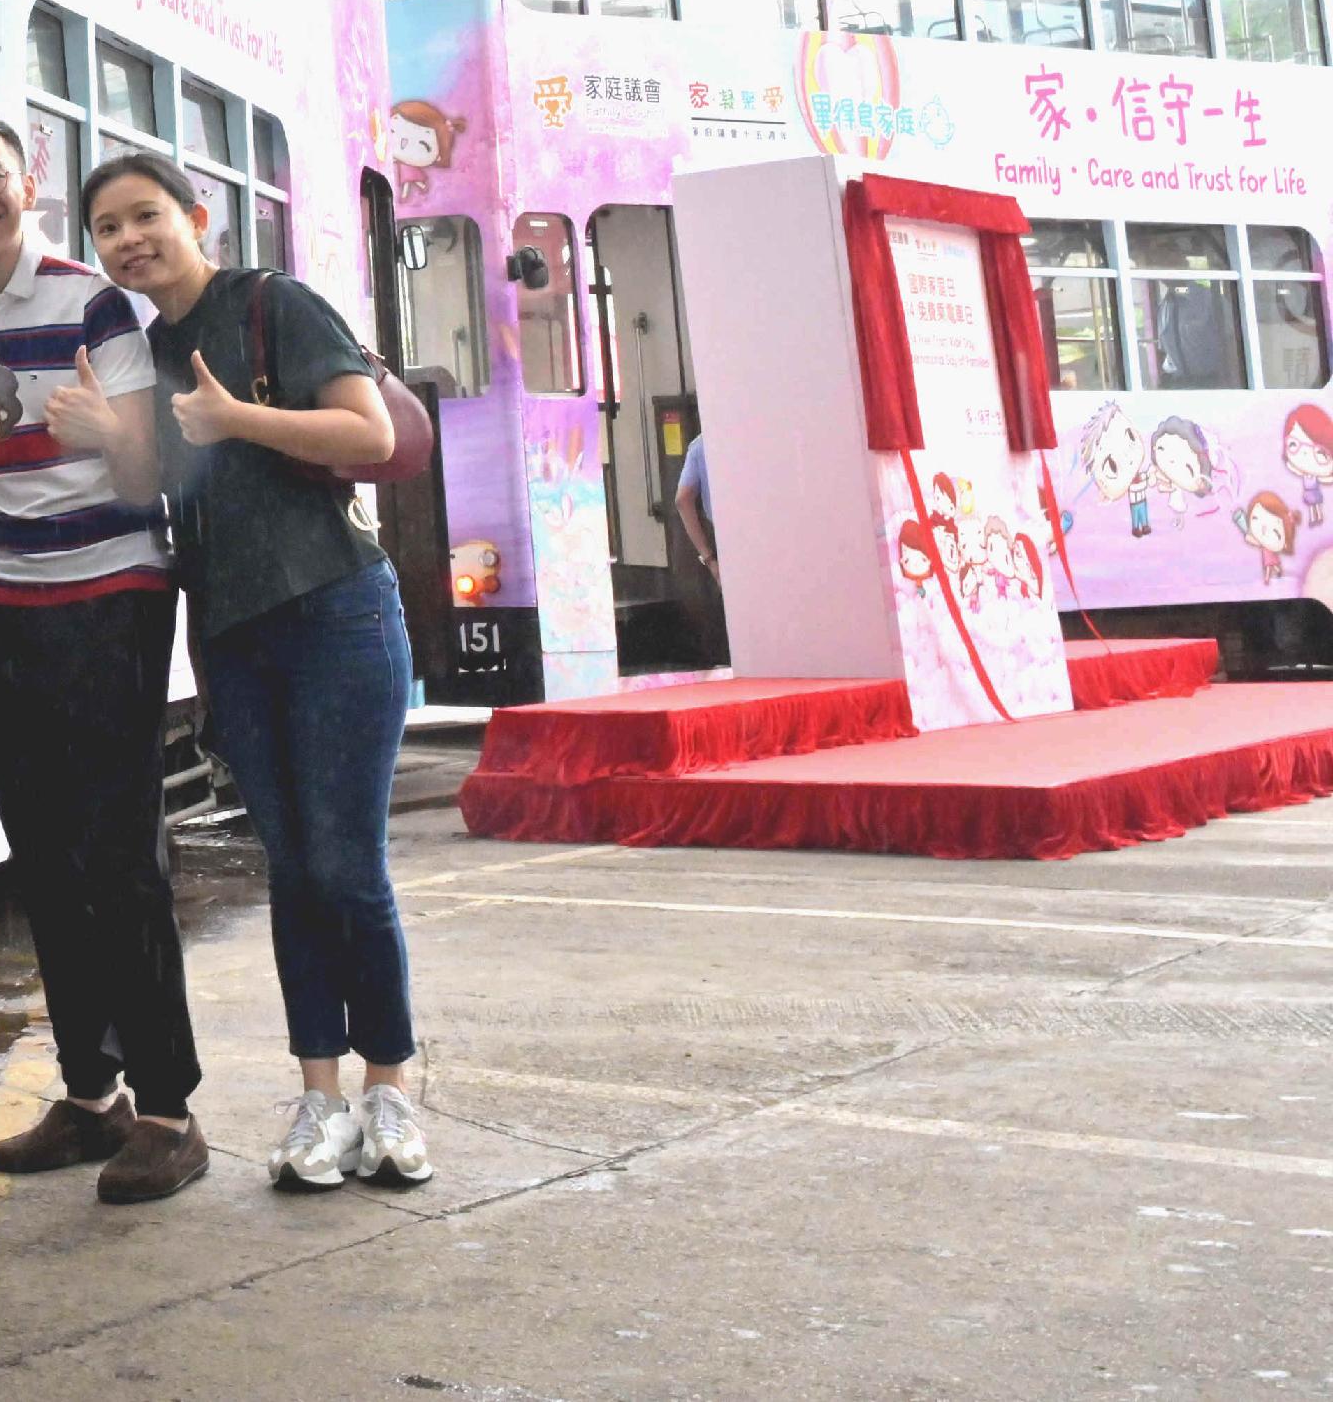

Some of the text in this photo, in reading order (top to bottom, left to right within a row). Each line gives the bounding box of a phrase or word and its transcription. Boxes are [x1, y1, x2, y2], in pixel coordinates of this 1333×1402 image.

[583, 74, 662, 104] 家庭議會
[994, 153, 1062, 195] Family
[1087, 158, 1135, 188] Care
[1141, 163, 1180, 190] and
[1184, 162, 1234, 192] Trust
[1239, 165, 1268, 195] for
[1273, 167, 1307, 196] Life
[459, 622, 500, 652] 151
